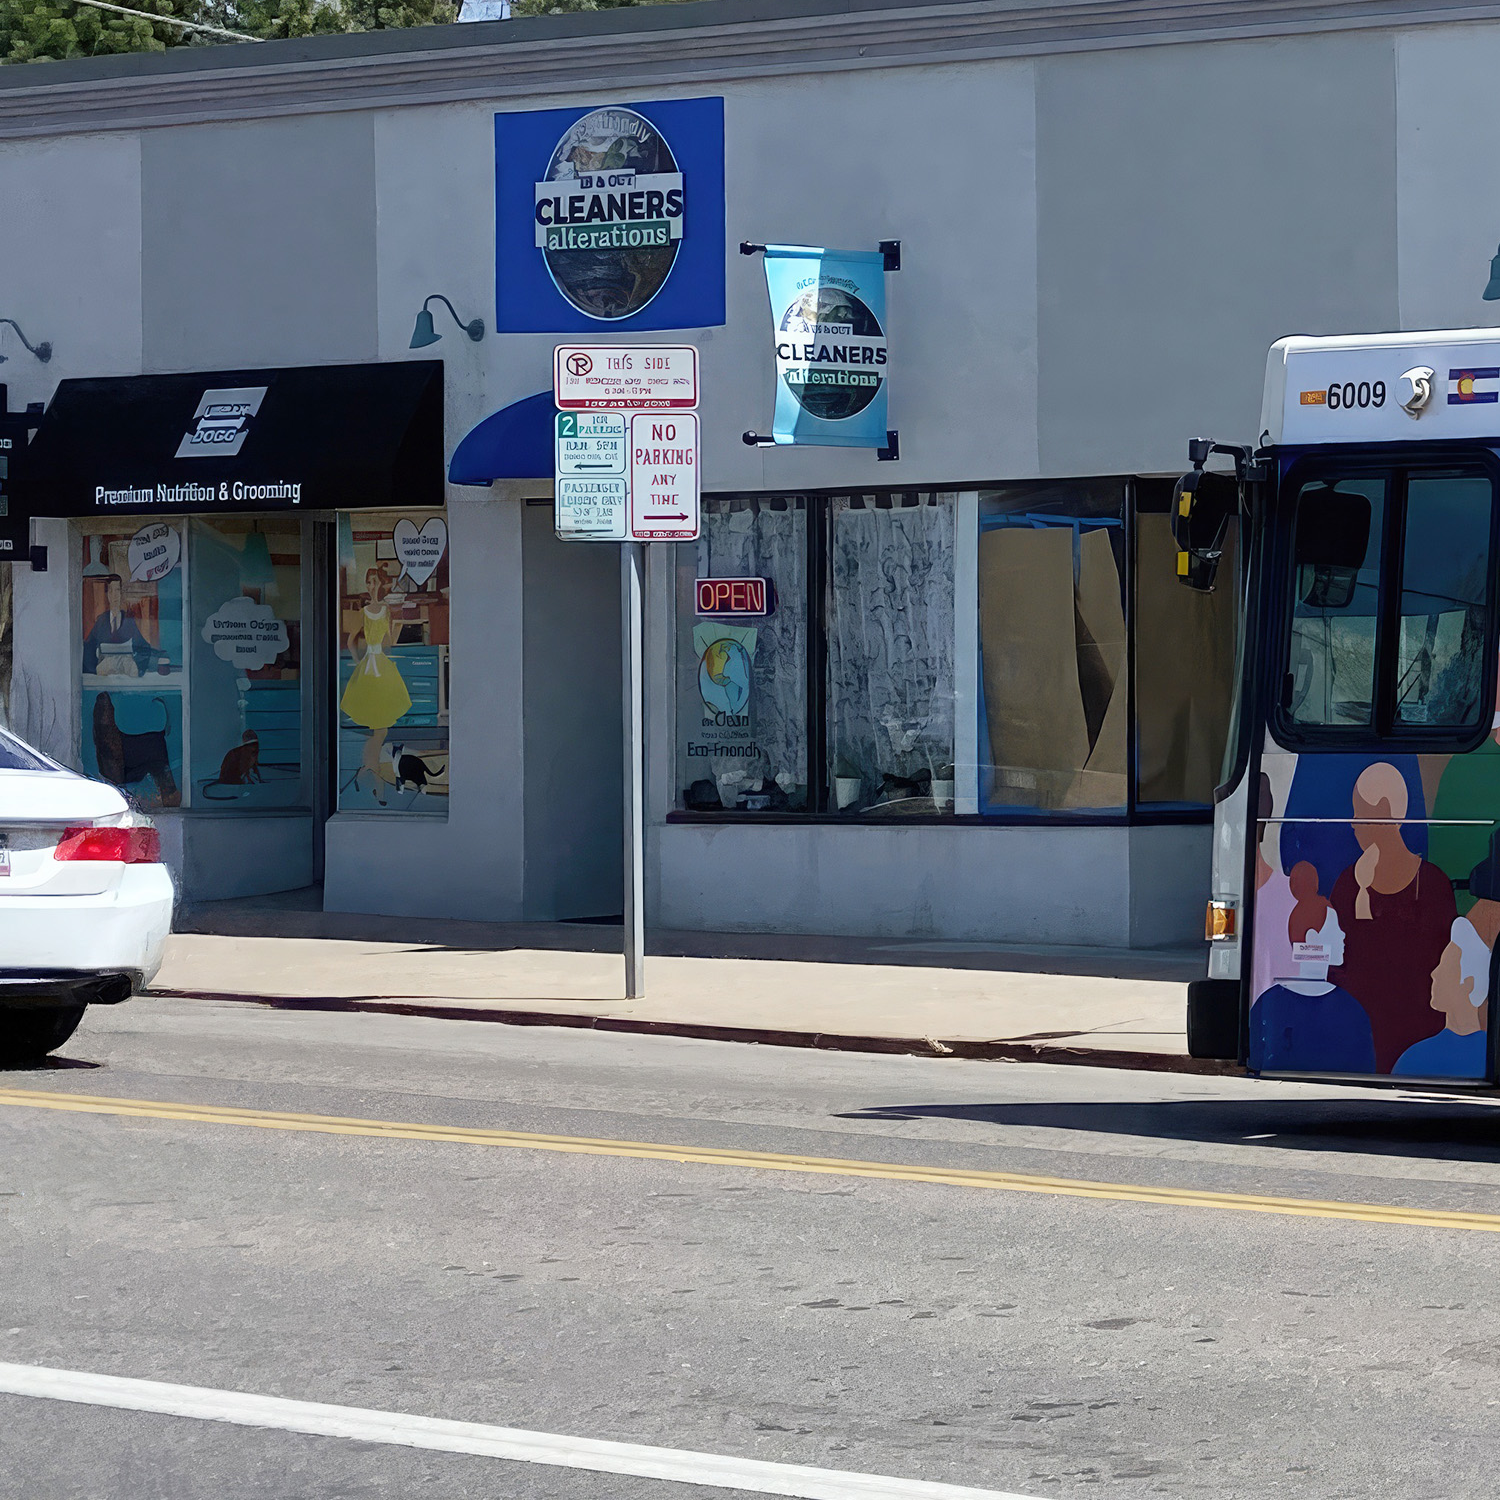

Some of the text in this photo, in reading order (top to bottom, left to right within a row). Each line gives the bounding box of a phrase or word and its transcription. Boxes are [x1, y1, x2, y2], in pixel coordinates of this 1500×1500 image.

[535, 189, 683, 226] CLEANERS
[548, 225, 668, 251] alterations
[777, 343, 888, 365] CLEANERS
[1327, 381, 1386, 410] 6009
[561, 415, 575, 436] 2
[651, 424, 676, 441] NO
[635, 448, 693, 466] PARKING
[232, 479, 301, 504] Grooming
[651, 474, 677, 486] ANY
[699, 582, 762, 611] OPEN
